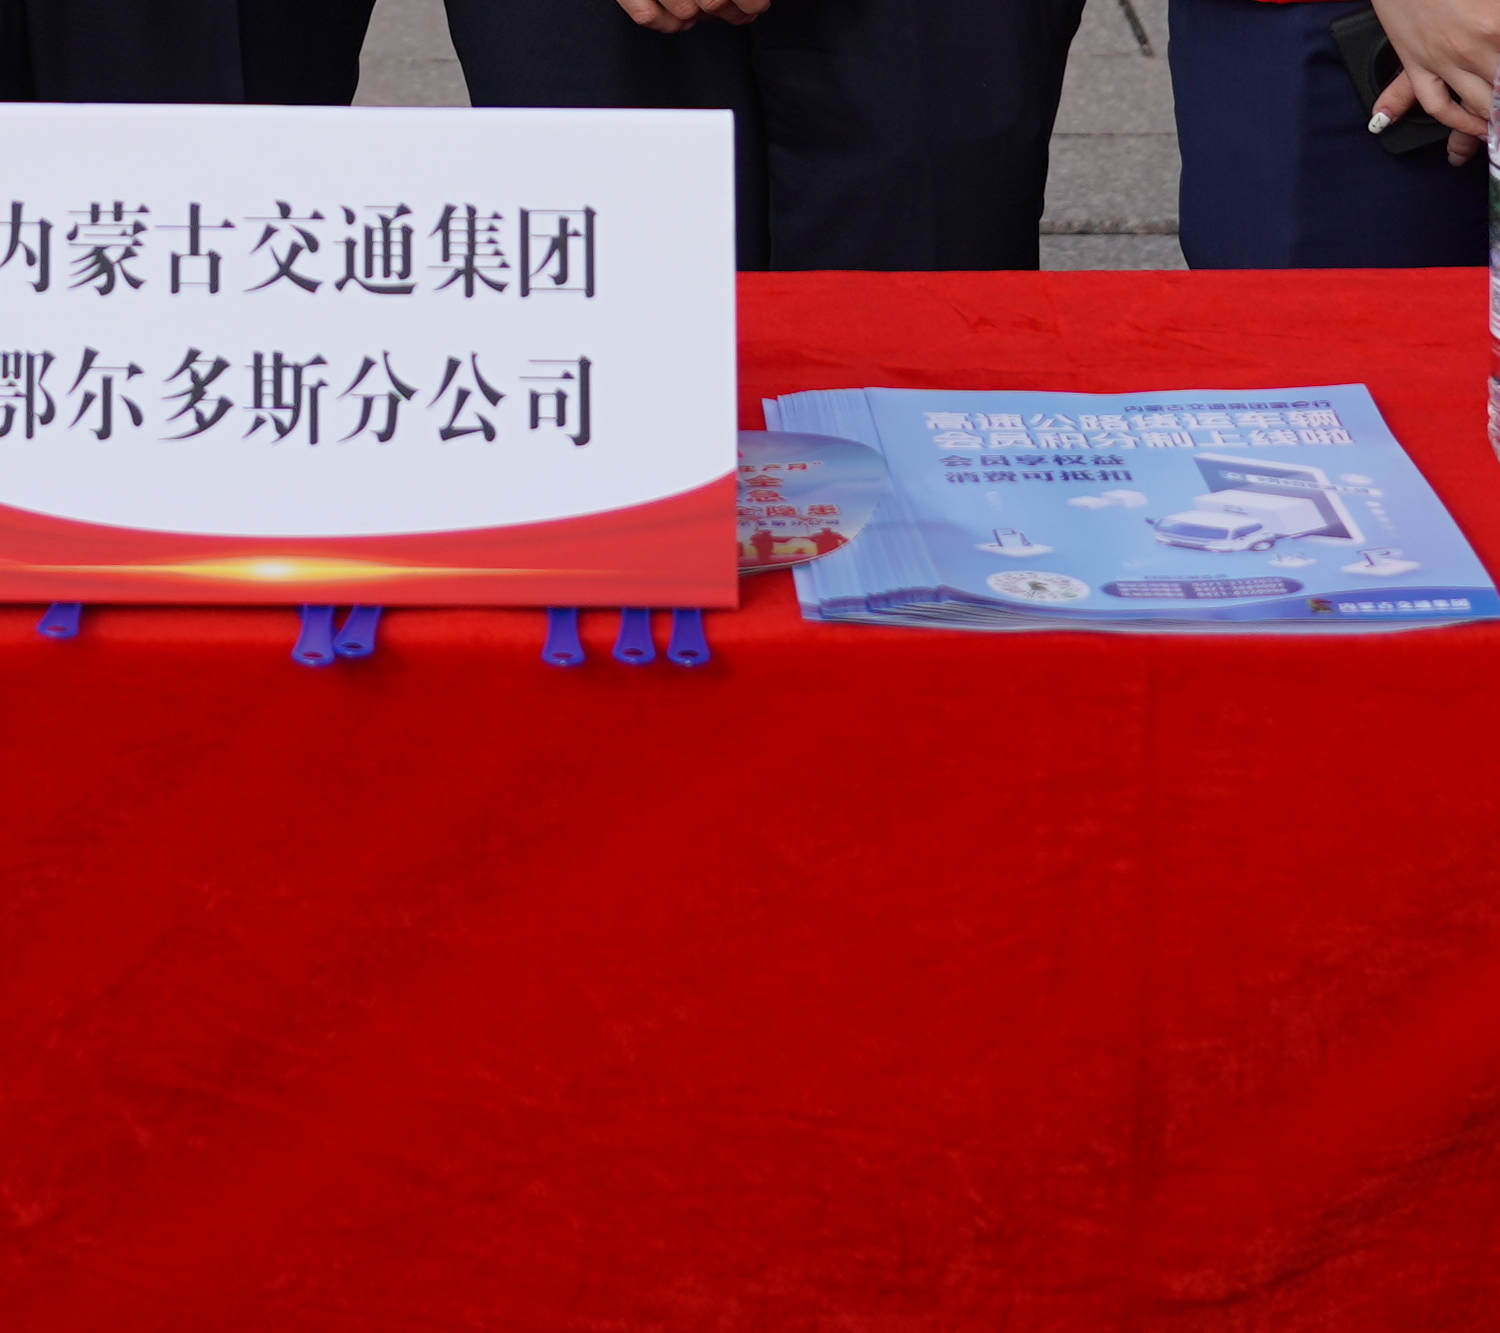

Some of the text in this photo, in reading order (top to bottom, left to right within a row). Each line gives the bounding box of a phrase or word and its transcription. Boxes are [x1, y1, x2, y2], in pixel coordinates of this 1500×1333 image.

[922, 409, 1343, 431] 高速公路货运车辆
[933, 428, 1355, 450] 会员积分制上线啦
[939, 454, 1126, 467] 会员享权益
[945, 469, 1133, 483] 消费可抵扣
